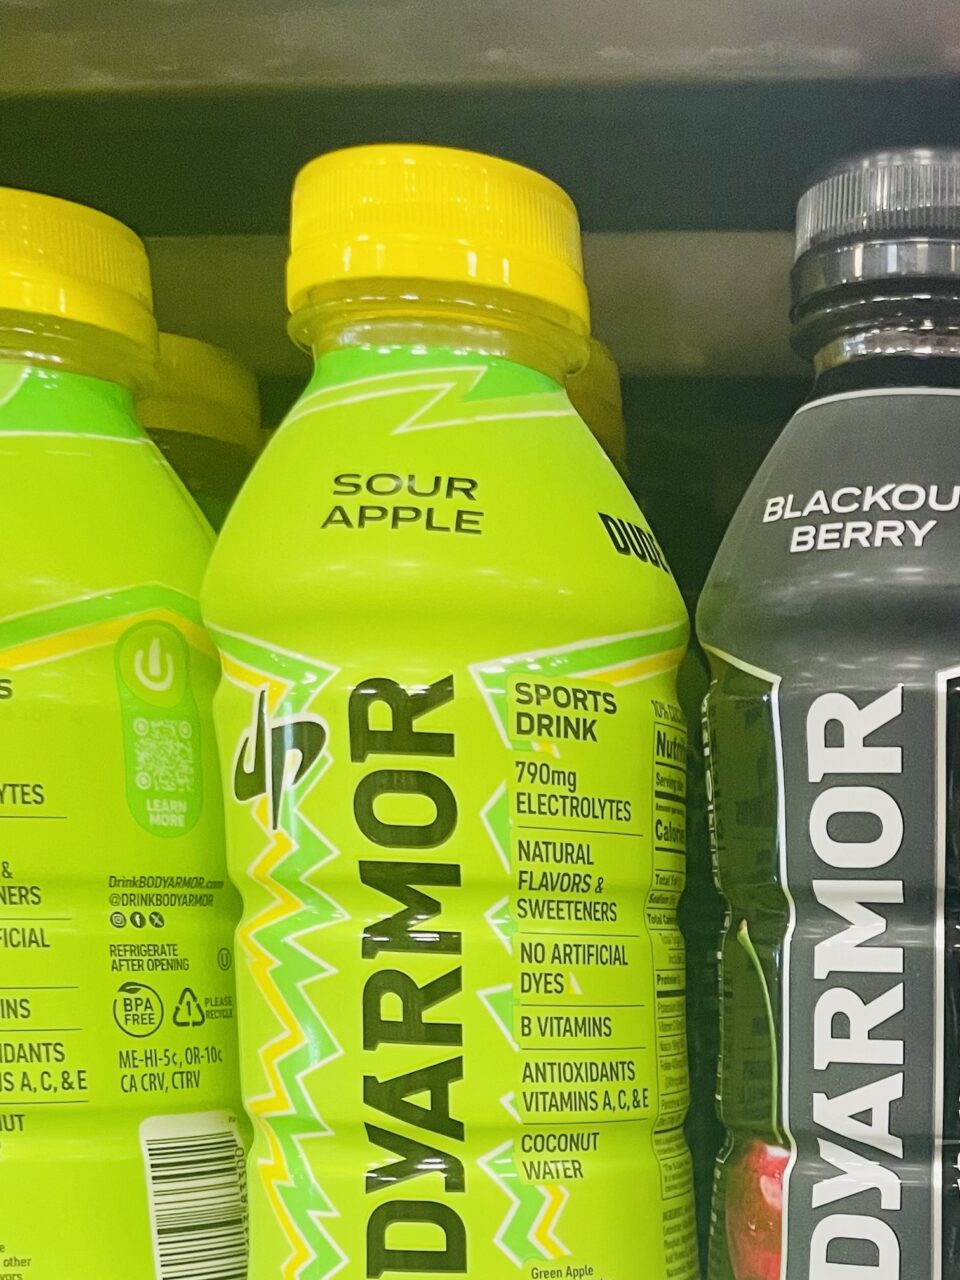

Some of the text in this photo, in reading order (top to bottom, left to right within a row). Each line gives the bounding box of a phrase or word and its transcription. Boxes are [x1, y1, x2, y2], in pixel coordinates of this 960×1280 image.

[332, 473, 479, 501] SOUR
[320, 505, 484, 535] APPLE
[790, 520, 937, 553] BERRY
[515, 682, 617, 715] SPORTS
[516, 712, 597, 742] DRINK
[515, 761, 577, 793] 790mg
[147, 799, 186, 812] LEARN
[516, 792, 631, 822] ELECTROLYTES
[150, 814, 185, 827] MORE
[518, 840, 594, 865] NATURAL
[518, 871, 604, 893] FLAVORS &
[517, 898, 617, 922] SWEETENERS
[109, 944, 178, 957] REFRIGERATE
[521, 942, 628, 966] NO ARTIFICIAL
[111, 959, 189, 972] AFTER OPENING
[521, 972, 564, 994] DYES
[124, 998, 153, 1012] BPA
[124, 1014, 155, 1025] FREE
[521, 1016, 612, 1037] B VITAMINS
[121, 1070, 201, 1093] CA CRV, CTRV
[522, 1061, 636, 1083] ANTIOXIDANTS
[522, 1091, 598, 1112] VITAMINS
[521, 1133, 599, 1153] COCONUT
[522, 1160, 584, 1180] WATER
[531, 1265, 594, 1280] Green Apple
